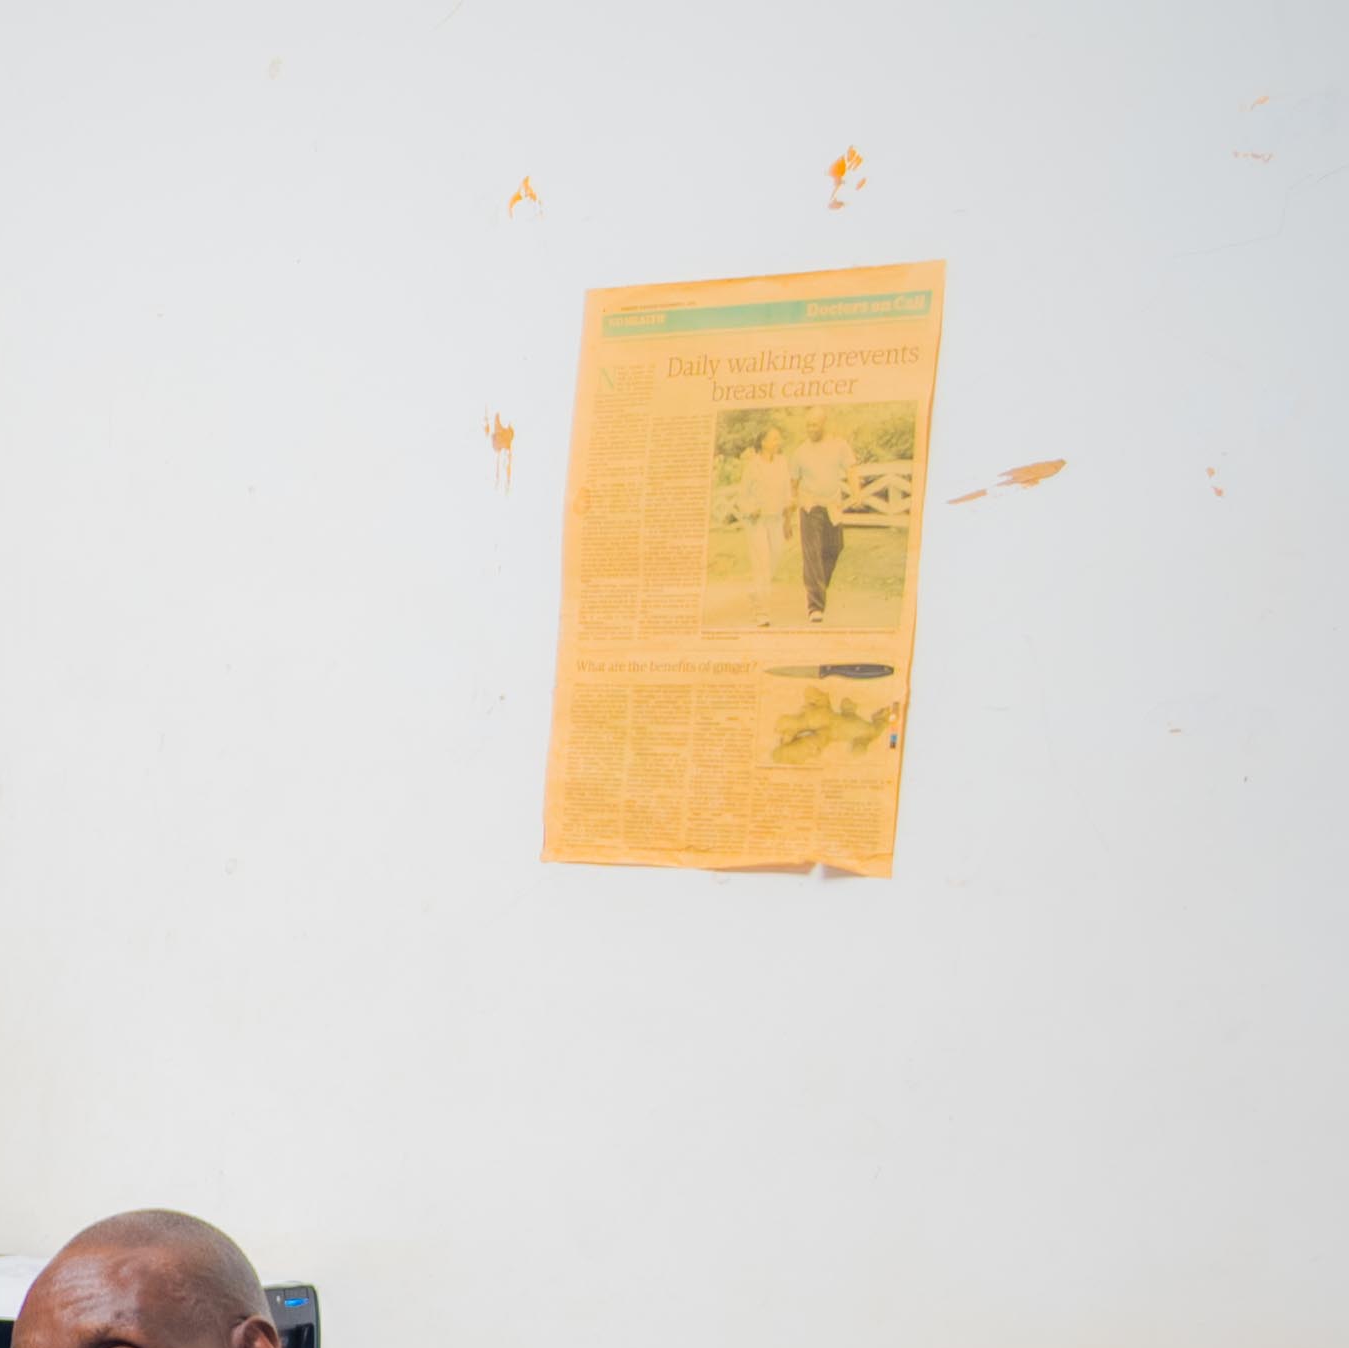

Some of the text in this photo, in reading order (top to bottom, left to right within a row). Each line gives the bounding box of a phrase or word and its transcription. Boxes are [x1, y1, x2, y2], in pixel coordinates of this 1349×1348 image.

[667, 343, 920, 379] Daily walking prevents
[712, 375, 858, 401] breast cancer
